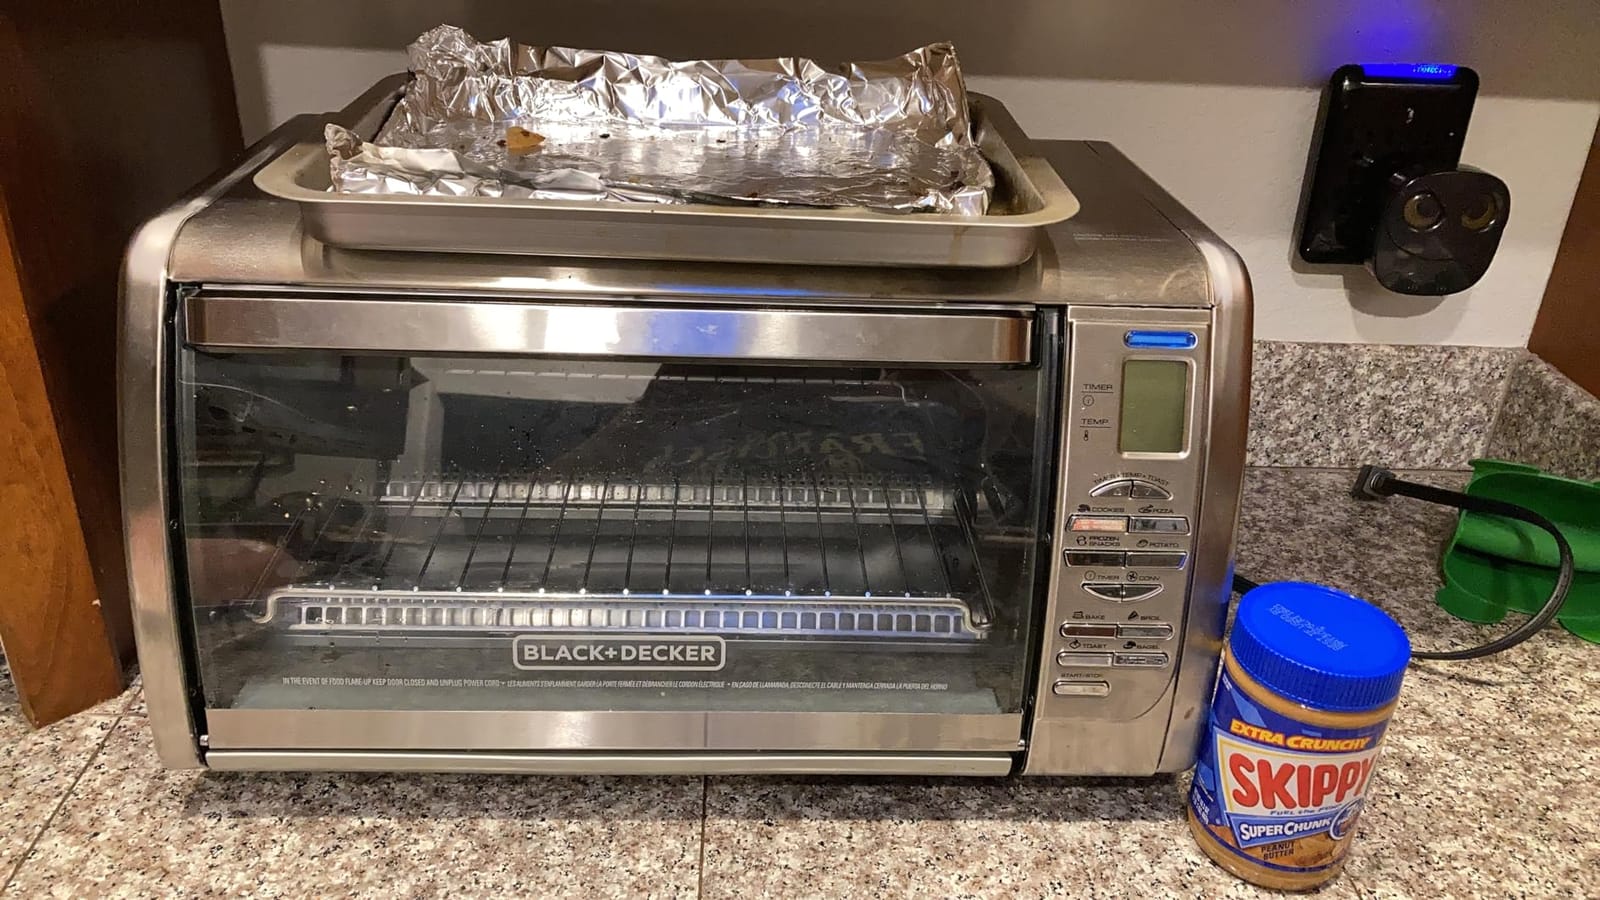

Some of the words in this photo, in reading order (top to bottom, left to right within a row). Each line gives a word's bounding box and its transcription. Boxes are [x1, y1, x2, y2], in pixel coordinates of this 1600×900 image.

[523, 644, 715, 661] BLACK+DECKER
[282, 677, 290, 686] IN
[290, 677, 302, 686] THE
[302, 677, 320, 686] EVENT
[321, 677, 328, 686] OF
[329, 677, 345, 686] FOOD
[372, 677, 387, 686] KEEP
[387, 678, 403, 686] DOOR
[404, 678, 425, 686] CLOSED
[426, 678, 439, 686] AND
[440, 678, 463, 686] UNPLUG
[463, 679, 484, 687] POWER
[485, 679, 500, 687] CORD
[1230, 719, 1285, 748] EXTRA
[1285, 735, 1372, 751] CRUNCHY
[1229, 752, 1377, 810] SKIPPY
[1261, 841, 1295, 853] PEANUT
[1263, 849, 1295, 861] BUTTER
